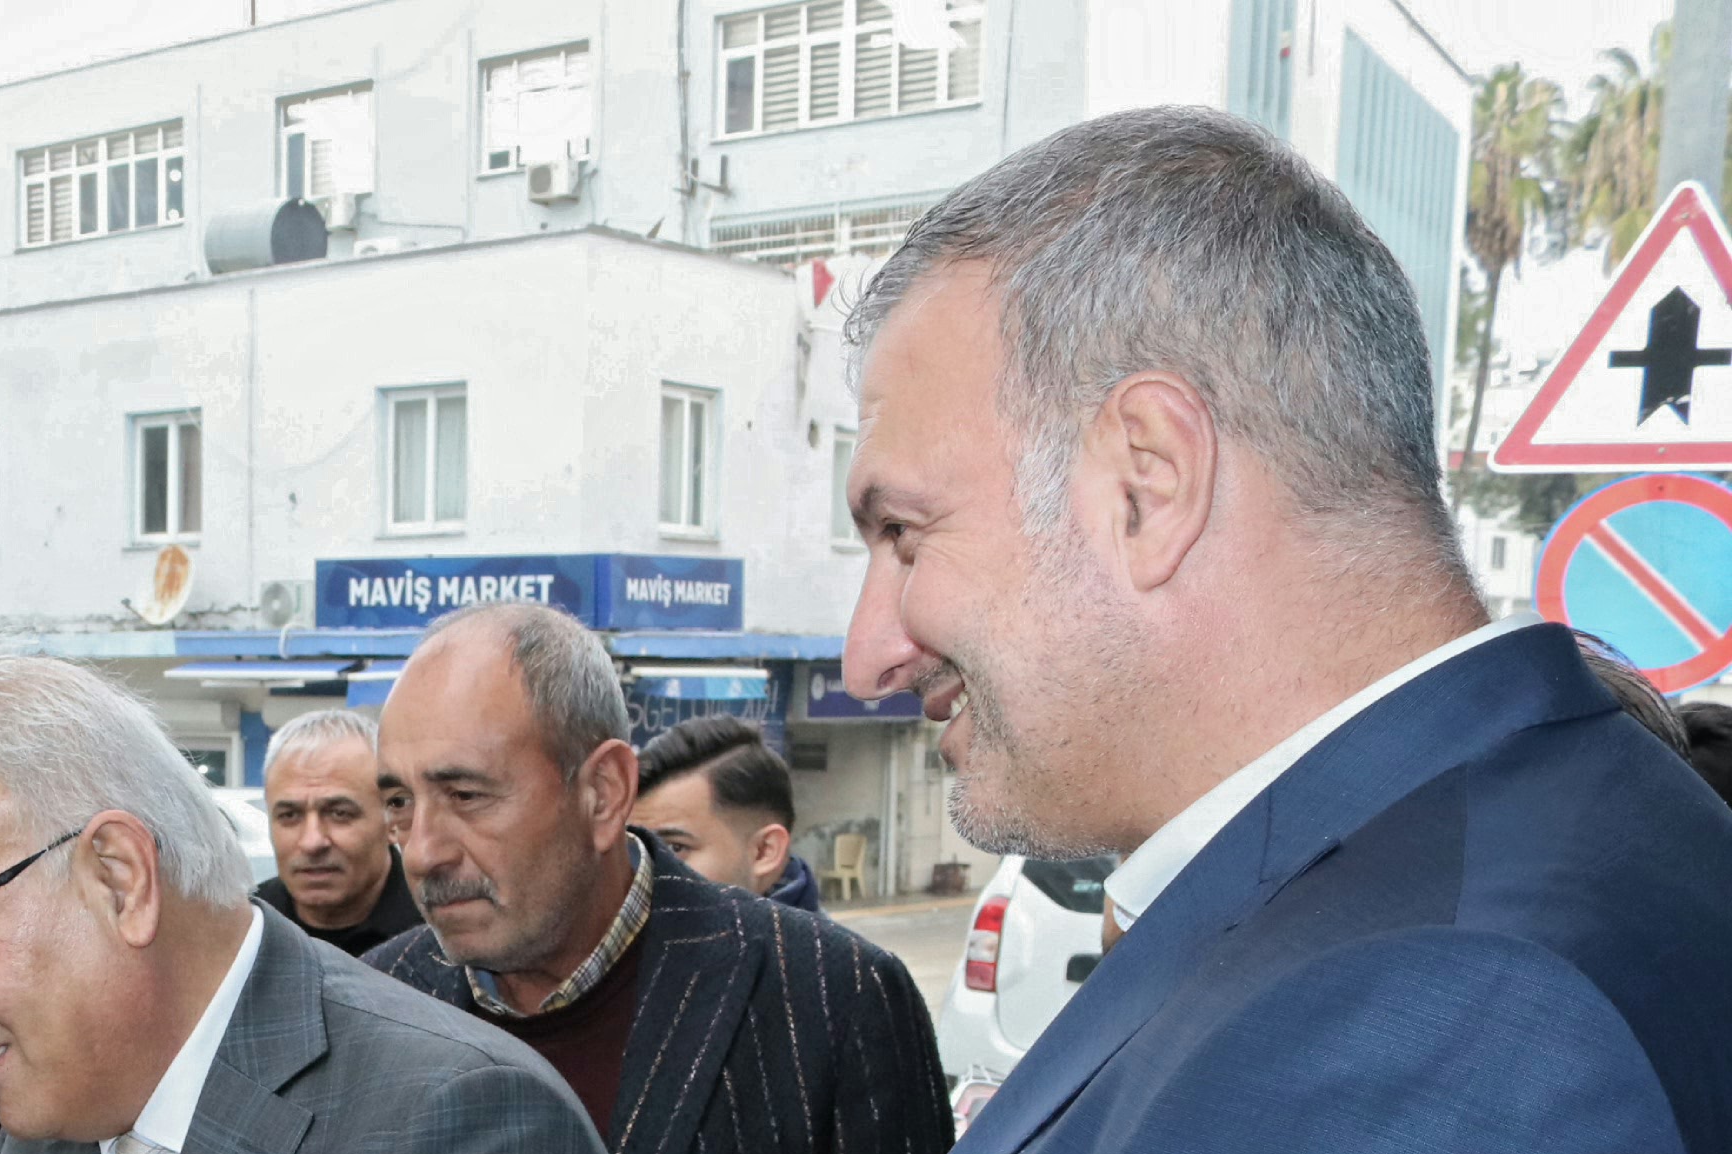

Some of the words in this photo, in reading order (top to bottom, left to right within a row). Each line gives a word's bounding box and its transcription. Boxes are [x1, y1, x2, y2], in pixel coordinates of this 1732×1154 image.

[349, 570, 432, 613] MAVİŞ
[438, 574, 555, 605] MARKET
[626, 573, 671, 608] MAVİŞ
[673, 580, 731, 606] MARKET
